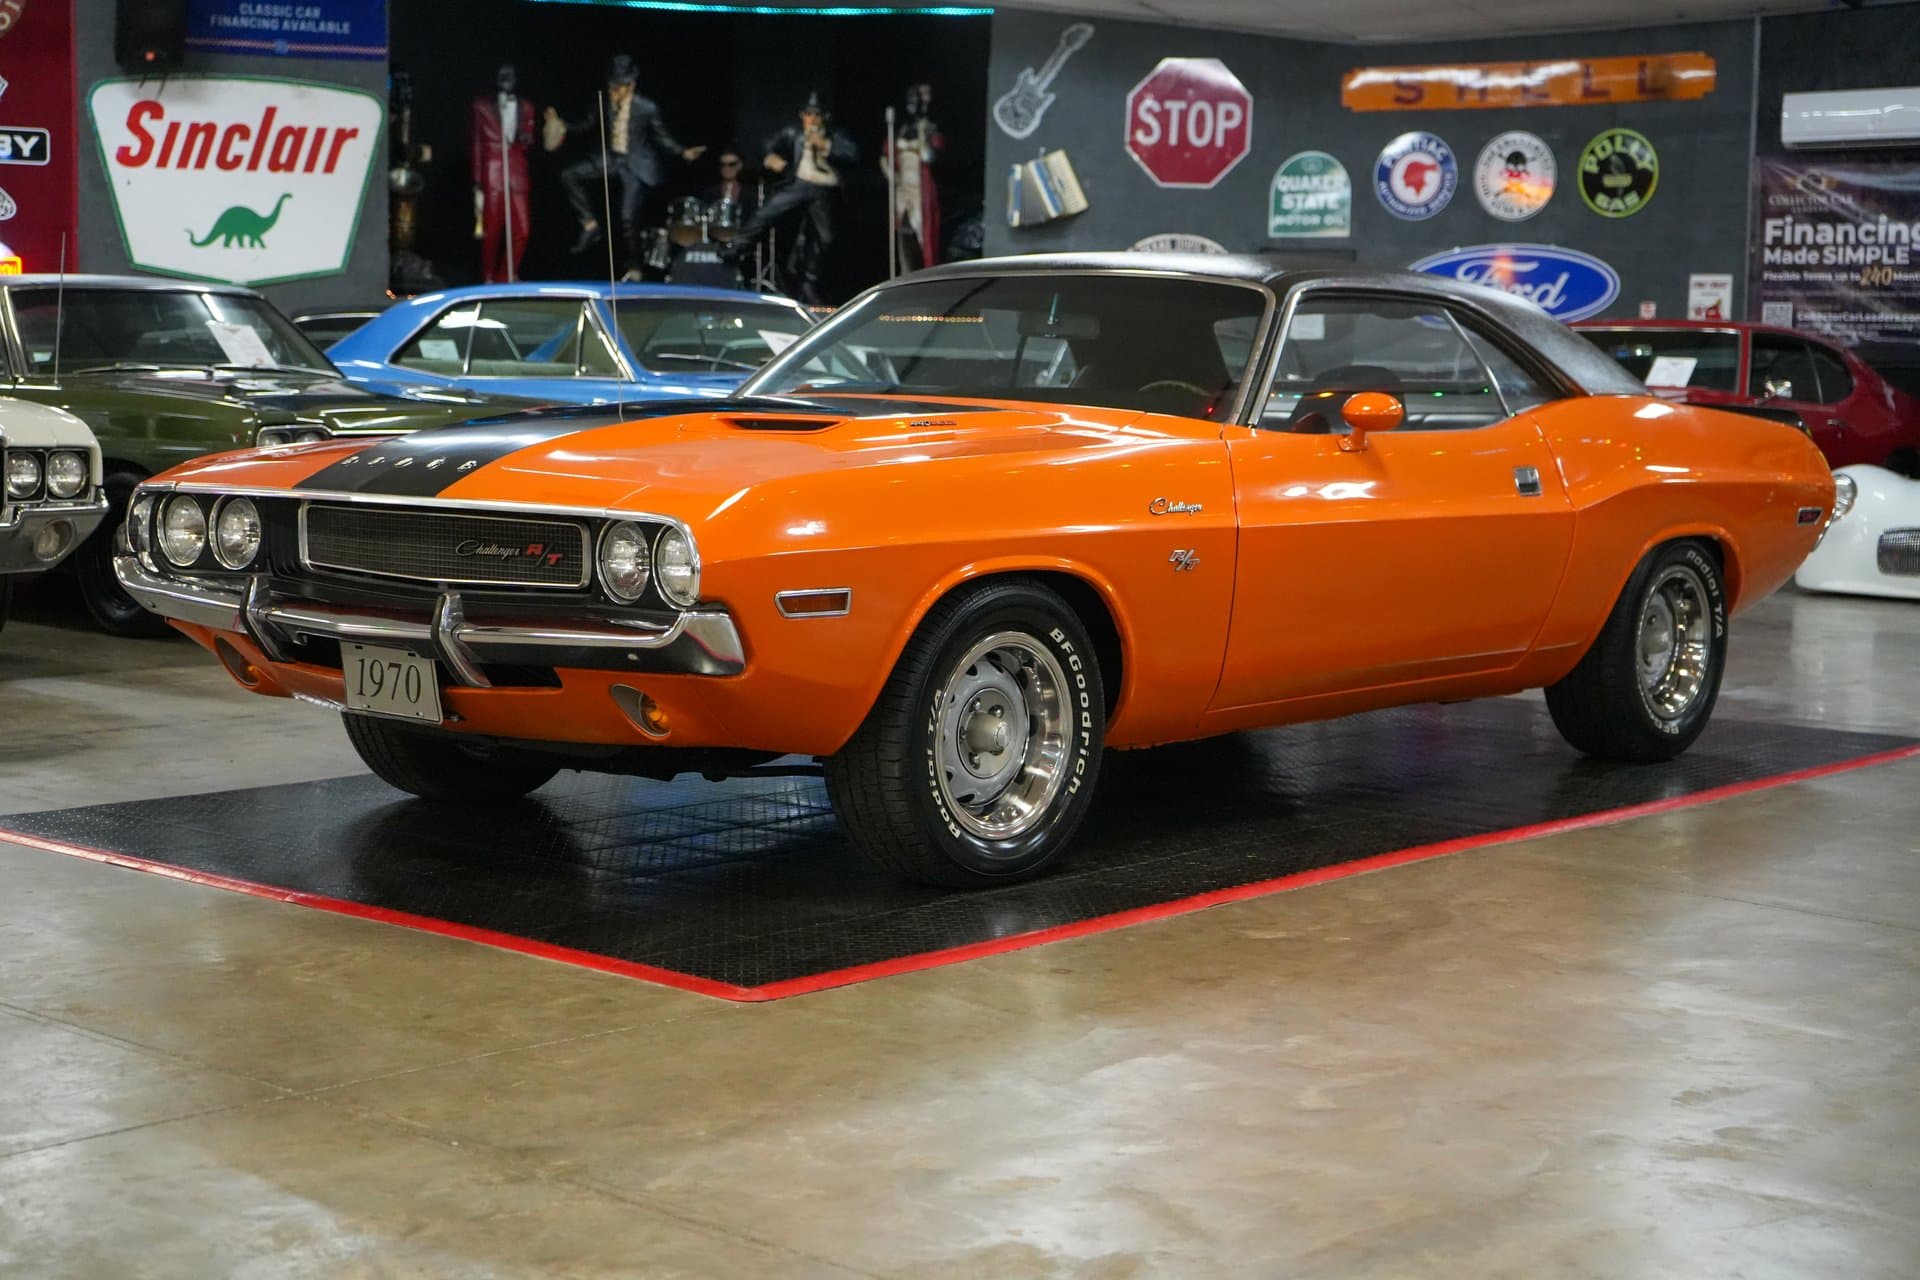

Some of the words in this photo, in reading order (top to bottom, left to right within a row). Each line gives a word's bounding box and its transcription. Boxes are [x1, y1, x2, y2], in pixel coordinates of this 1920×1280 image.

[239, 3, 293, 17] CLASSIC
[295, 6, 321, 19] CAR
[210, 15, 280, 31] FINANCING
[282, 18, 351, 34] AVAILABLE
[1136, 98, 1243, 148] STOP
[116, 100, 359, 174] Sinclair
[1583, 135, 1655, 174] POLLY
[1277, 175, 1346, 193] QUAKER
[1281, 194, 1340, 210] STATE
[1763, 247, 1821, 265] Made
[1823, 246, 1910, 265] SIMPLE
[1834, 273, 1848, 283] up
[1850, 271, 1861, 282] to
[1860, 266, 1893, 287] 240
[1893, 271, 1920, 281] Mont
[1149, 496, 1203, 516] Challenger
[455, 539, 521, 561] Challenger
[526, 543, 564, 568] R/T
[1168, 548, 1201, 571] R/T
[1714, 602, 1723, 640] T/A
[355, 658, 422, 703] 1970
[1050, 627, 1093, 795] BFGoodrich
